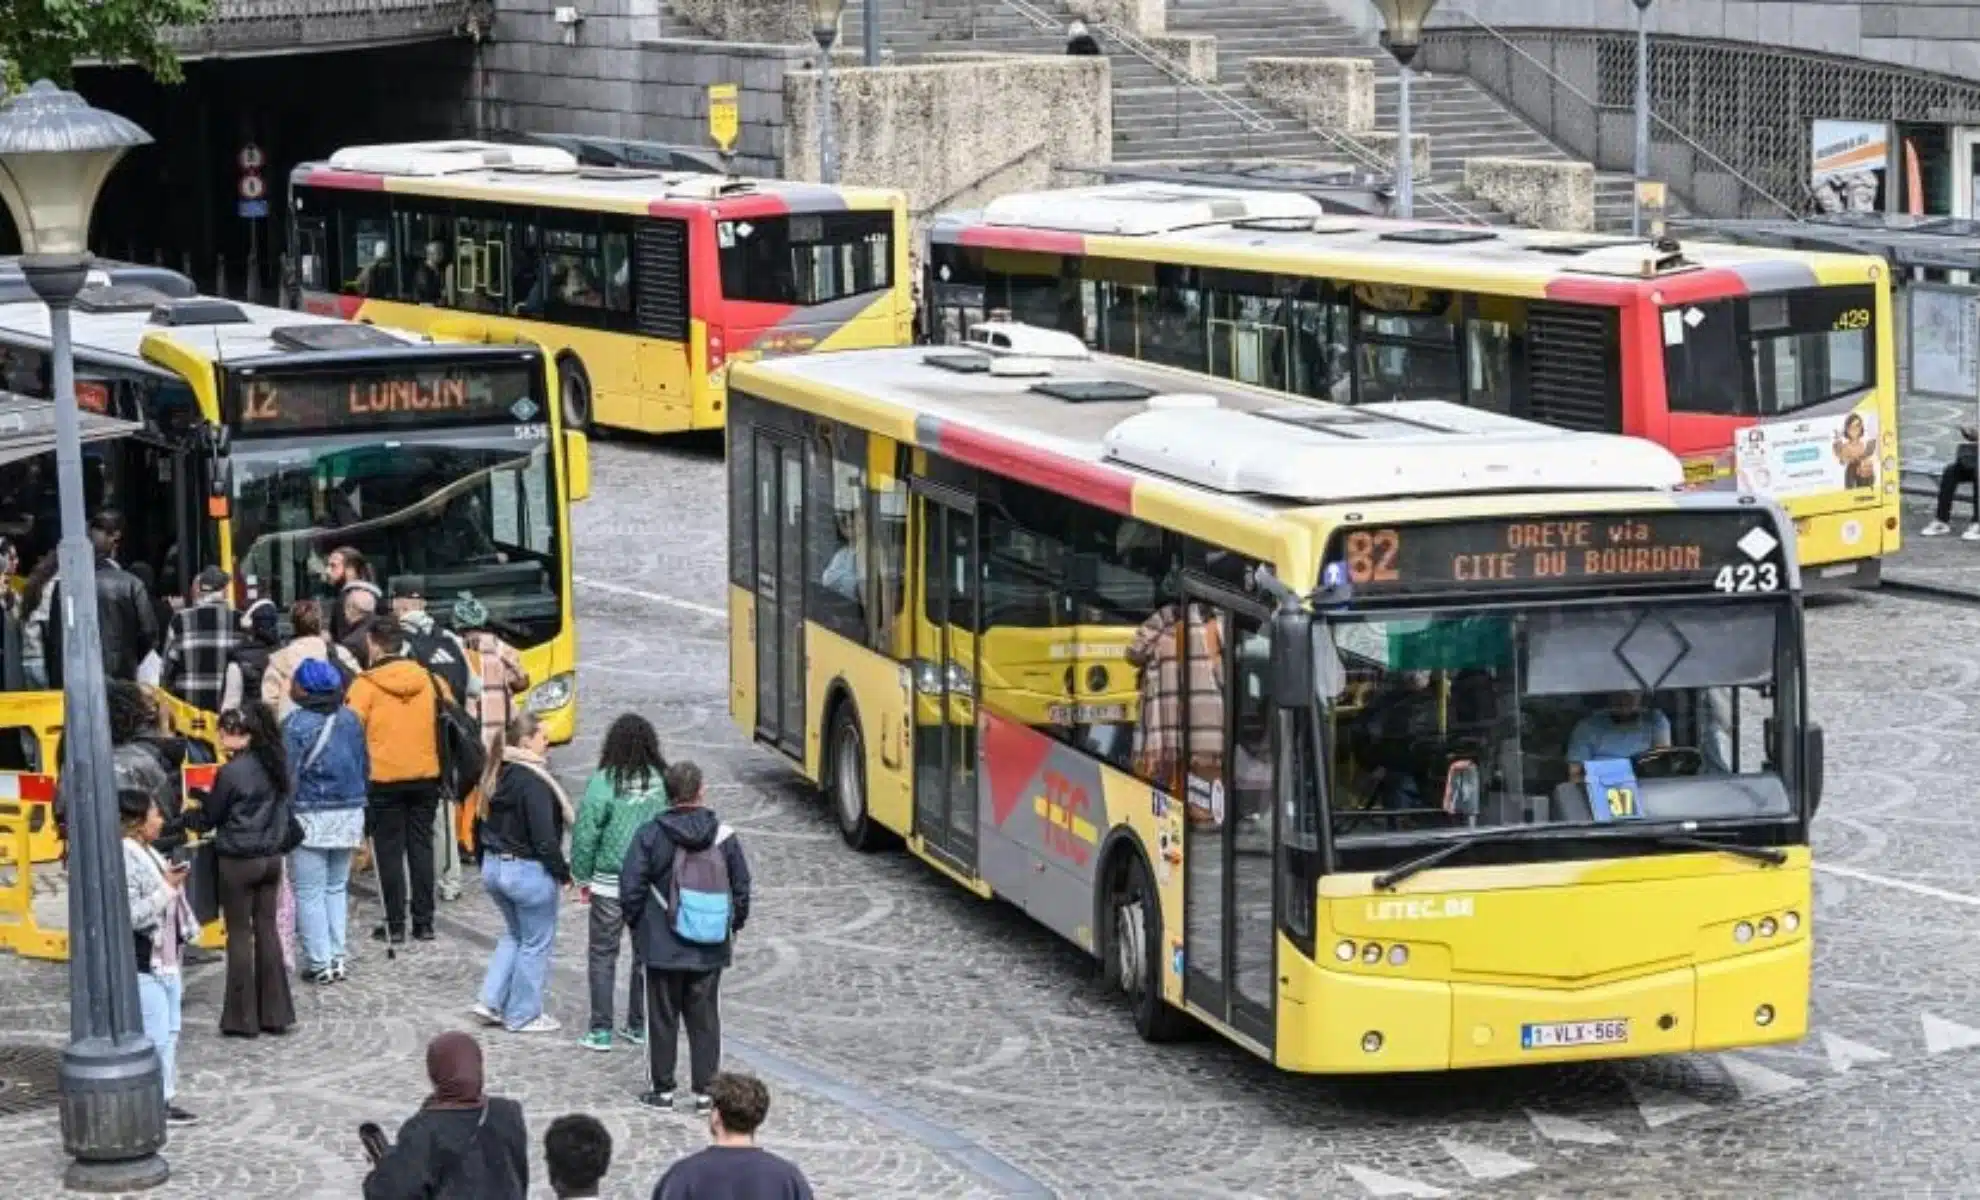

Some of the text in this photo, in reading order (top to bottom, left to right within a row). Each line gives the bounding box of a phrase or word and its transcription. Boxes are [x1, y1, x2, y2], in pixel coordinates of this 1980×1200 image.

[1507, 520, 1649, 549] OREYE via
[1347, 530, 1400, 583] 82
[1454, 545, 1702, 581] CITE DU BOURDON
[1715, 562, 1779, 592] 423
[1034, 770, 1097, 866] TEC
